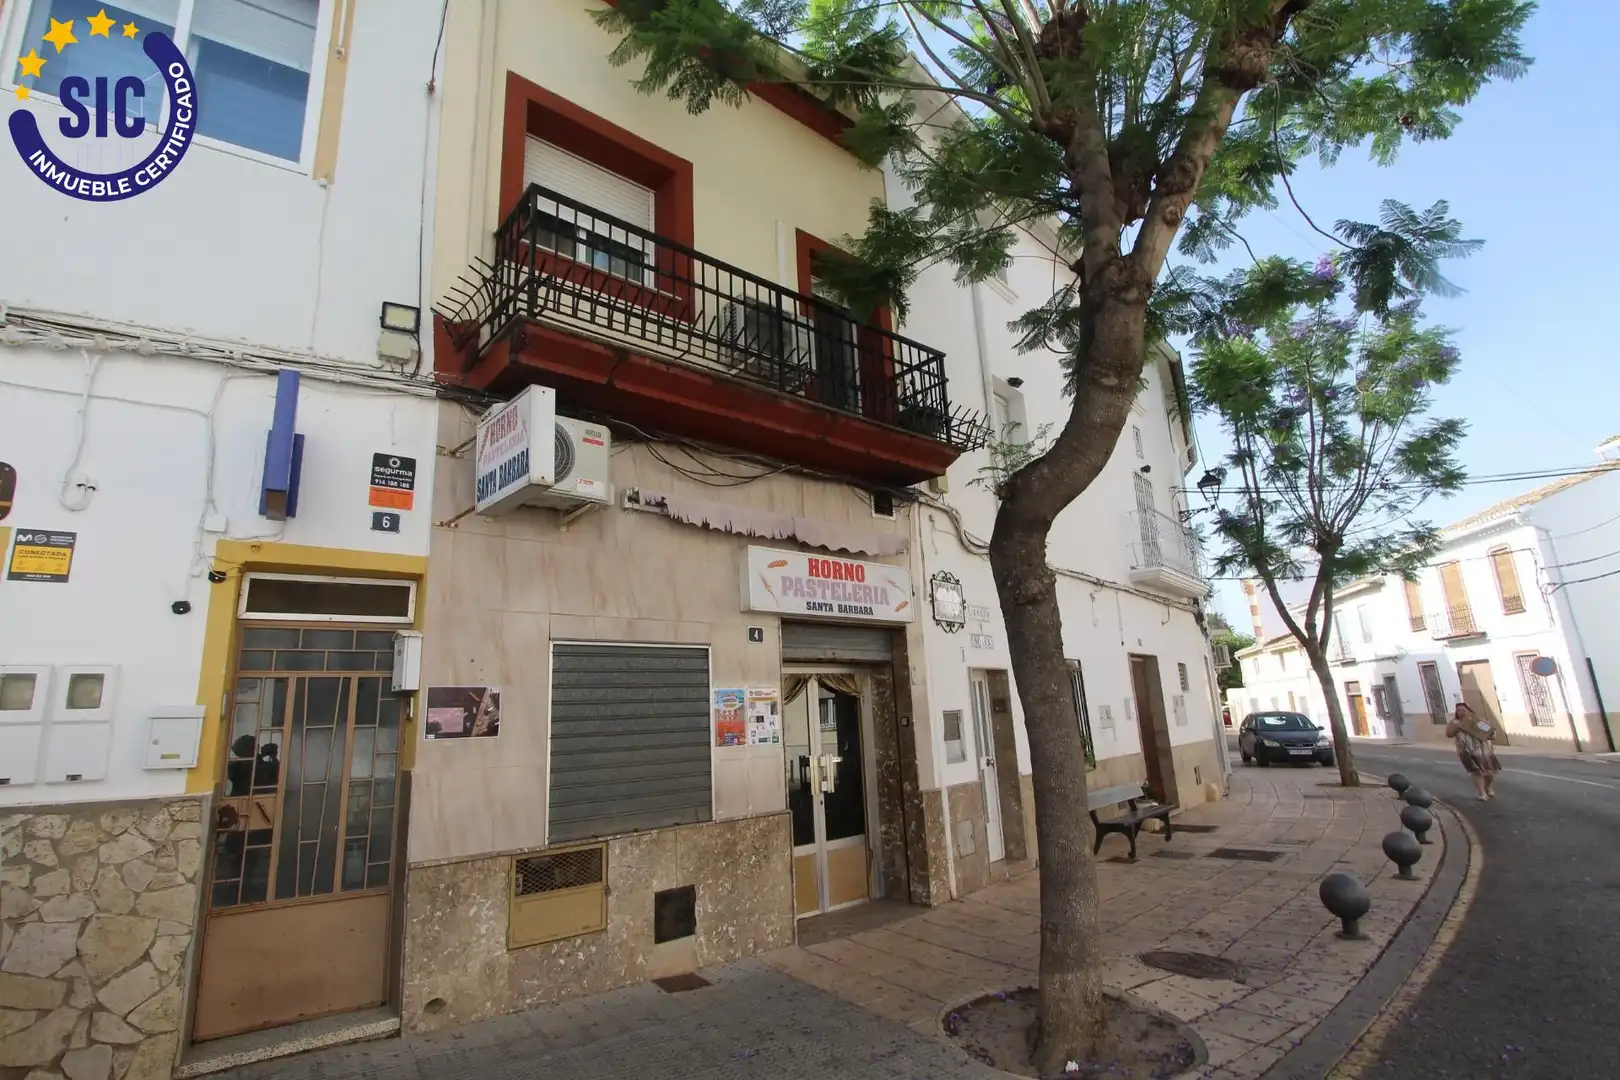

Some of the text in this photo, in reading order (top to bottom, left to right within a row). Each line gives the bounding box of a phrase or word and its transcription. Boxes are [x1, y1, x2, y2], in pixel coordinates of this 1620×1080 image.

[490, 405, 518, 447] HORNO
[374, 466, 413, 477] segurma
[477, 447, 529, 503] SANTA BARBARA
[382, 516, 391, 528] 6
[808, 558, 865, 583] HORNO
[781, 576, 890, 605] PASTELERIA
[806, 601, 874, 616] SANTA BARBARA
[753, 630, 760, 640] 4
